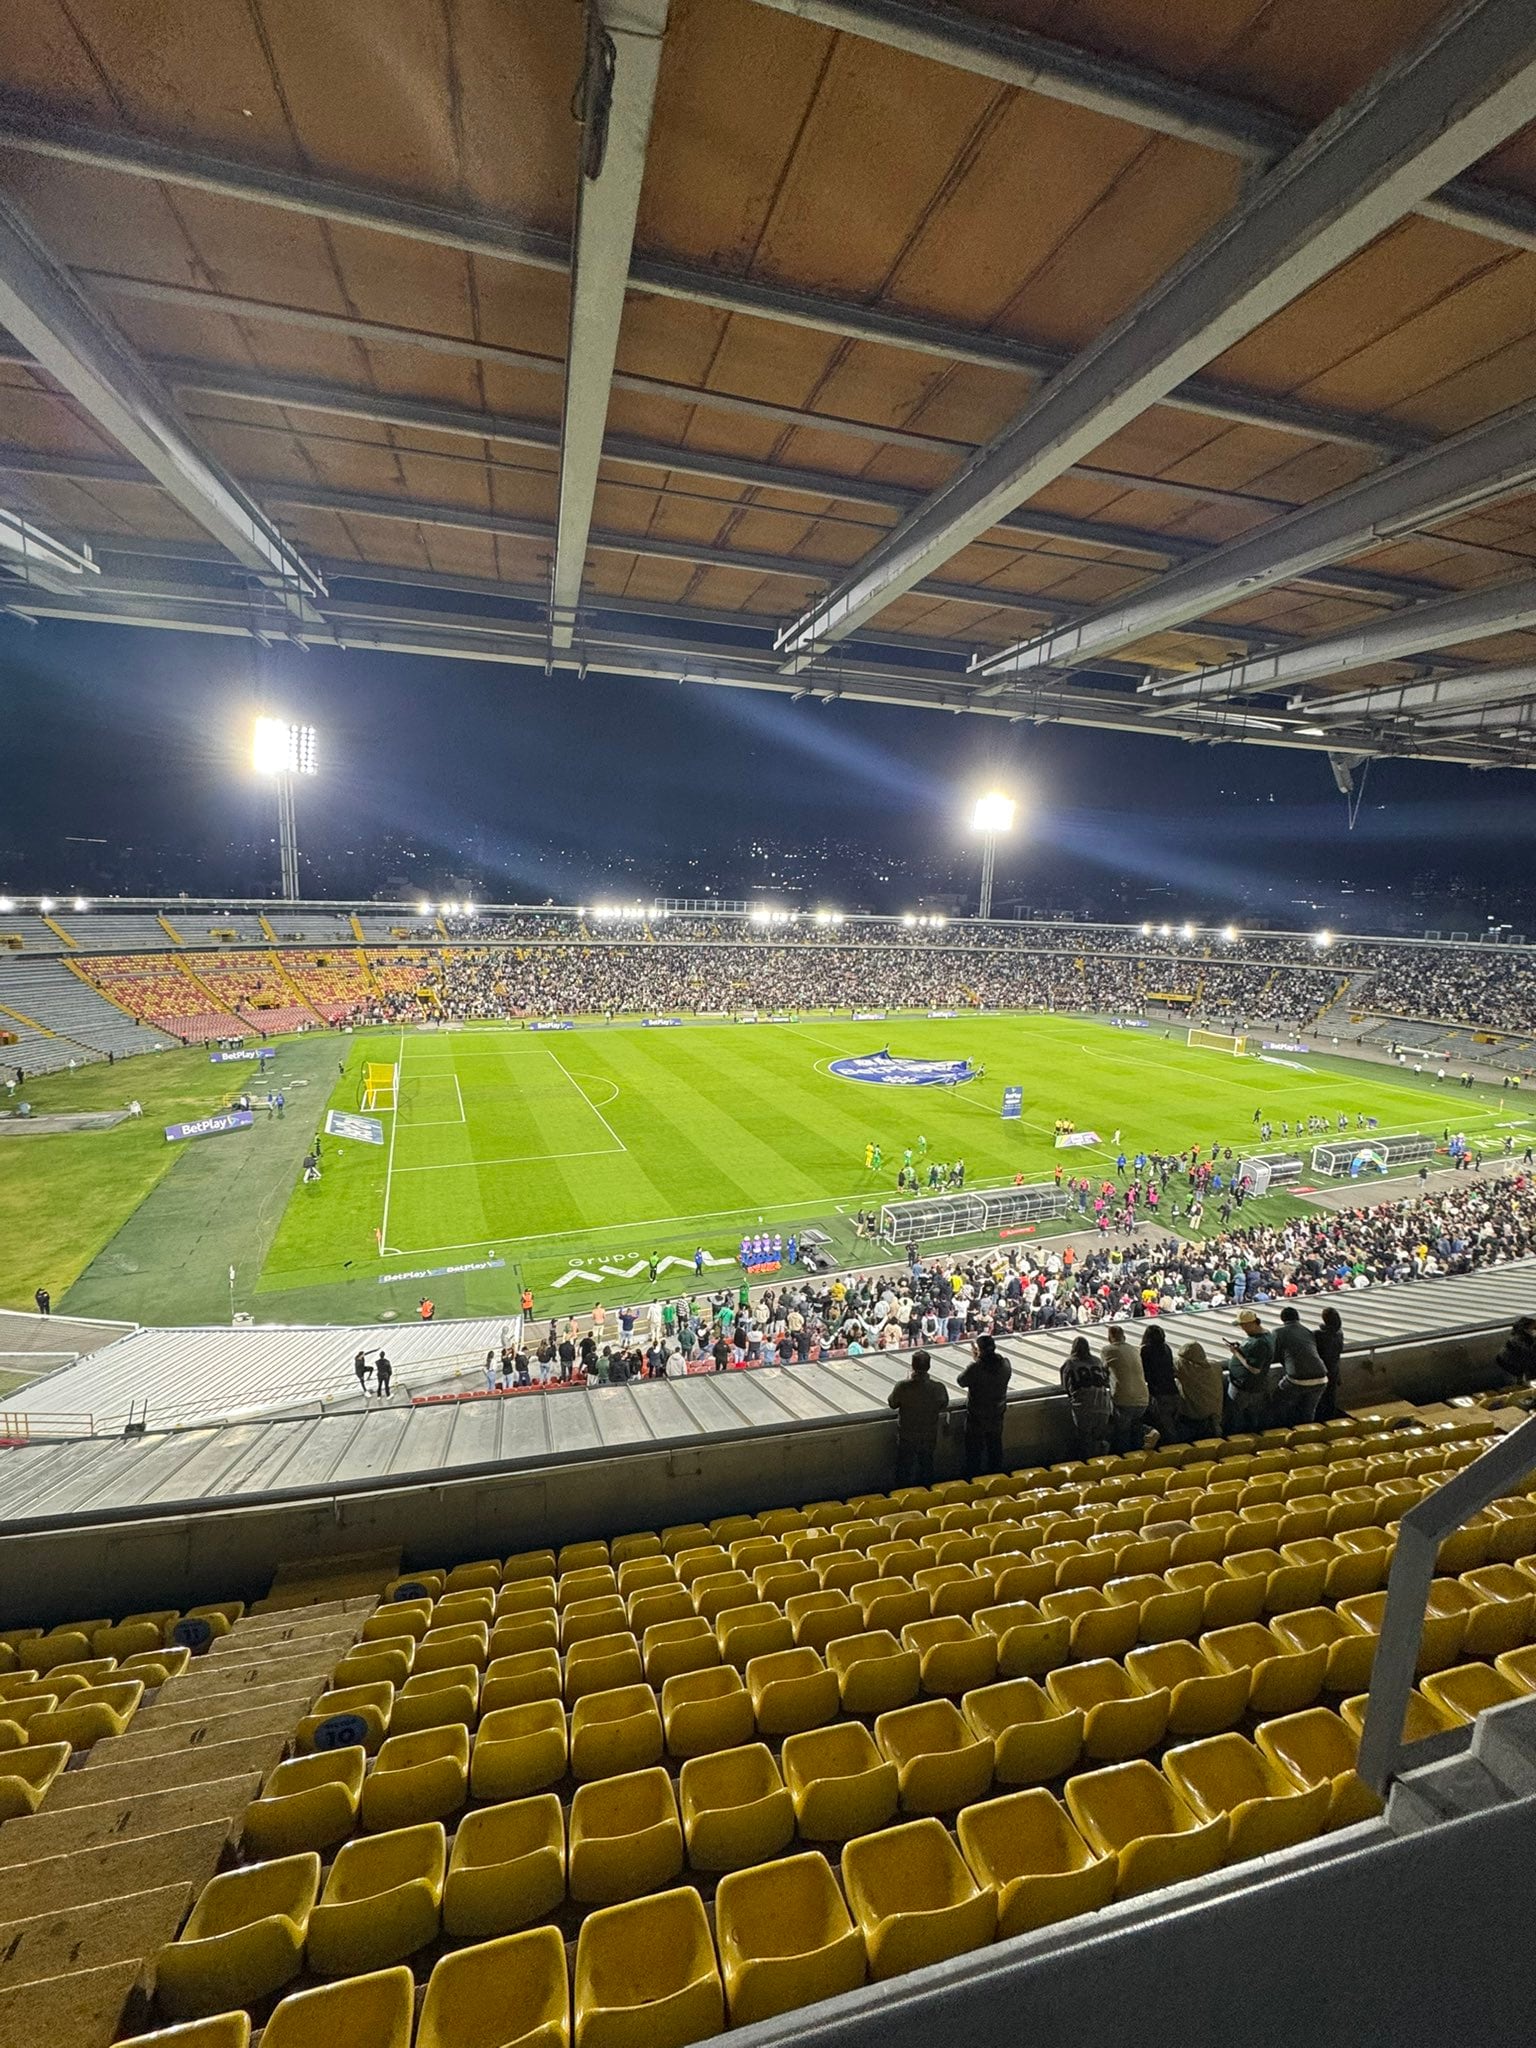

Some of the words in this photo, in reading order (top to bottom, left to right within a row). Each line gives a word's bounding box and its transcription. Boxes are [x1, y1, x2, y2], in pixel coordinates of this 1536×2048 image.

[221, 1050, 255, 1060] BetPlay
[181, 1118, 227, 1135] BetPlay
[568, 1252, 640, 1267] Grupo
[383, 1271, 427, 1282] BetPlay
[446, 1261, 488, 1273] BetPlay
[550, 1251, 737, 1288] AVAL
[326, 1728, 355, 1746] 10
